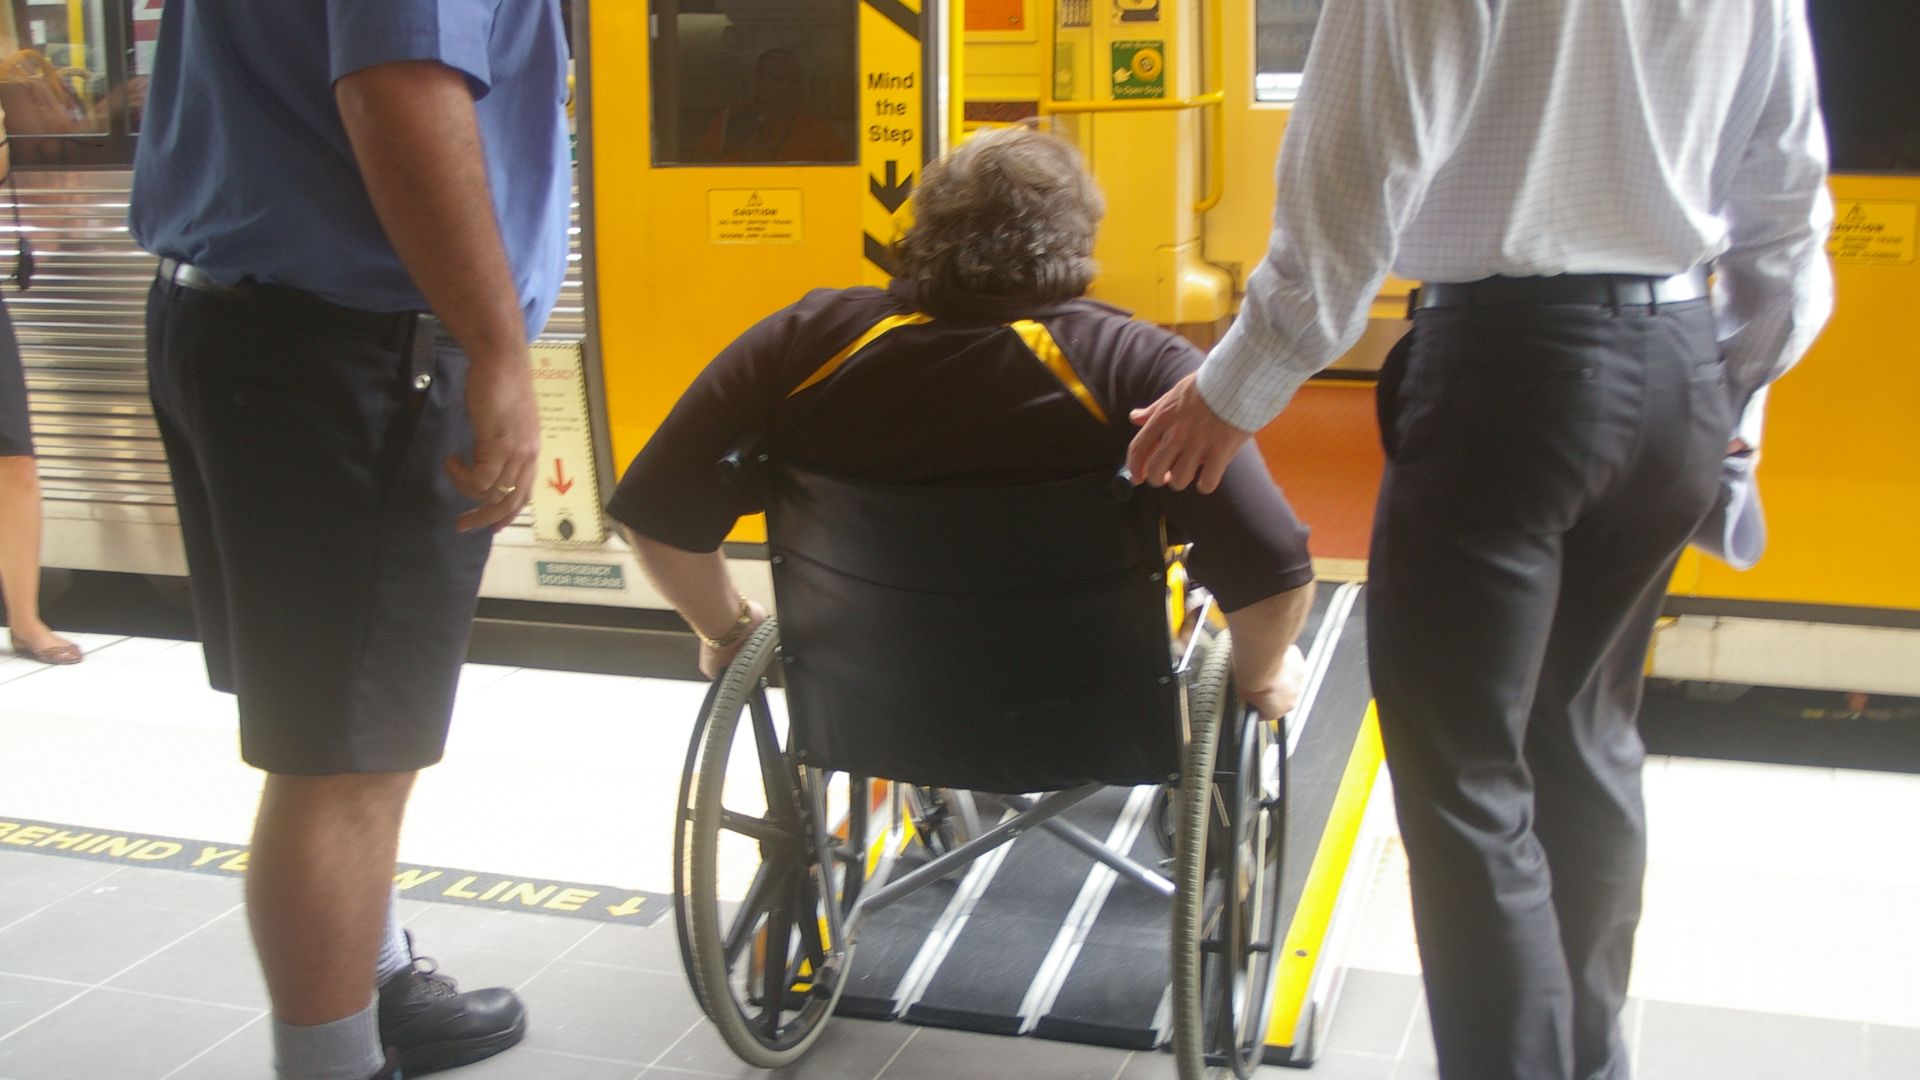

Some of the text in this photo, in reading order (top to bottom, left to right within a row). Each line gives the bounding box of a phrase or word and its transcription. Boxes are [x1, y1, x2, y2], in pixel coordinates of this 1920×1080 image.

[868, 72, 914, 89] Mind
[876, 99, 906, 116] the
[868, 125, 914, 145] Step
[732, 208, 778, 216] CAUTION
[1830, 221, 1885, 232] AUTION
[545, 563, 612, 576] EMERGENCY
[540, 574, 624, 588] DOOR RELEASE
[442, 875, 600, 912] LINE
